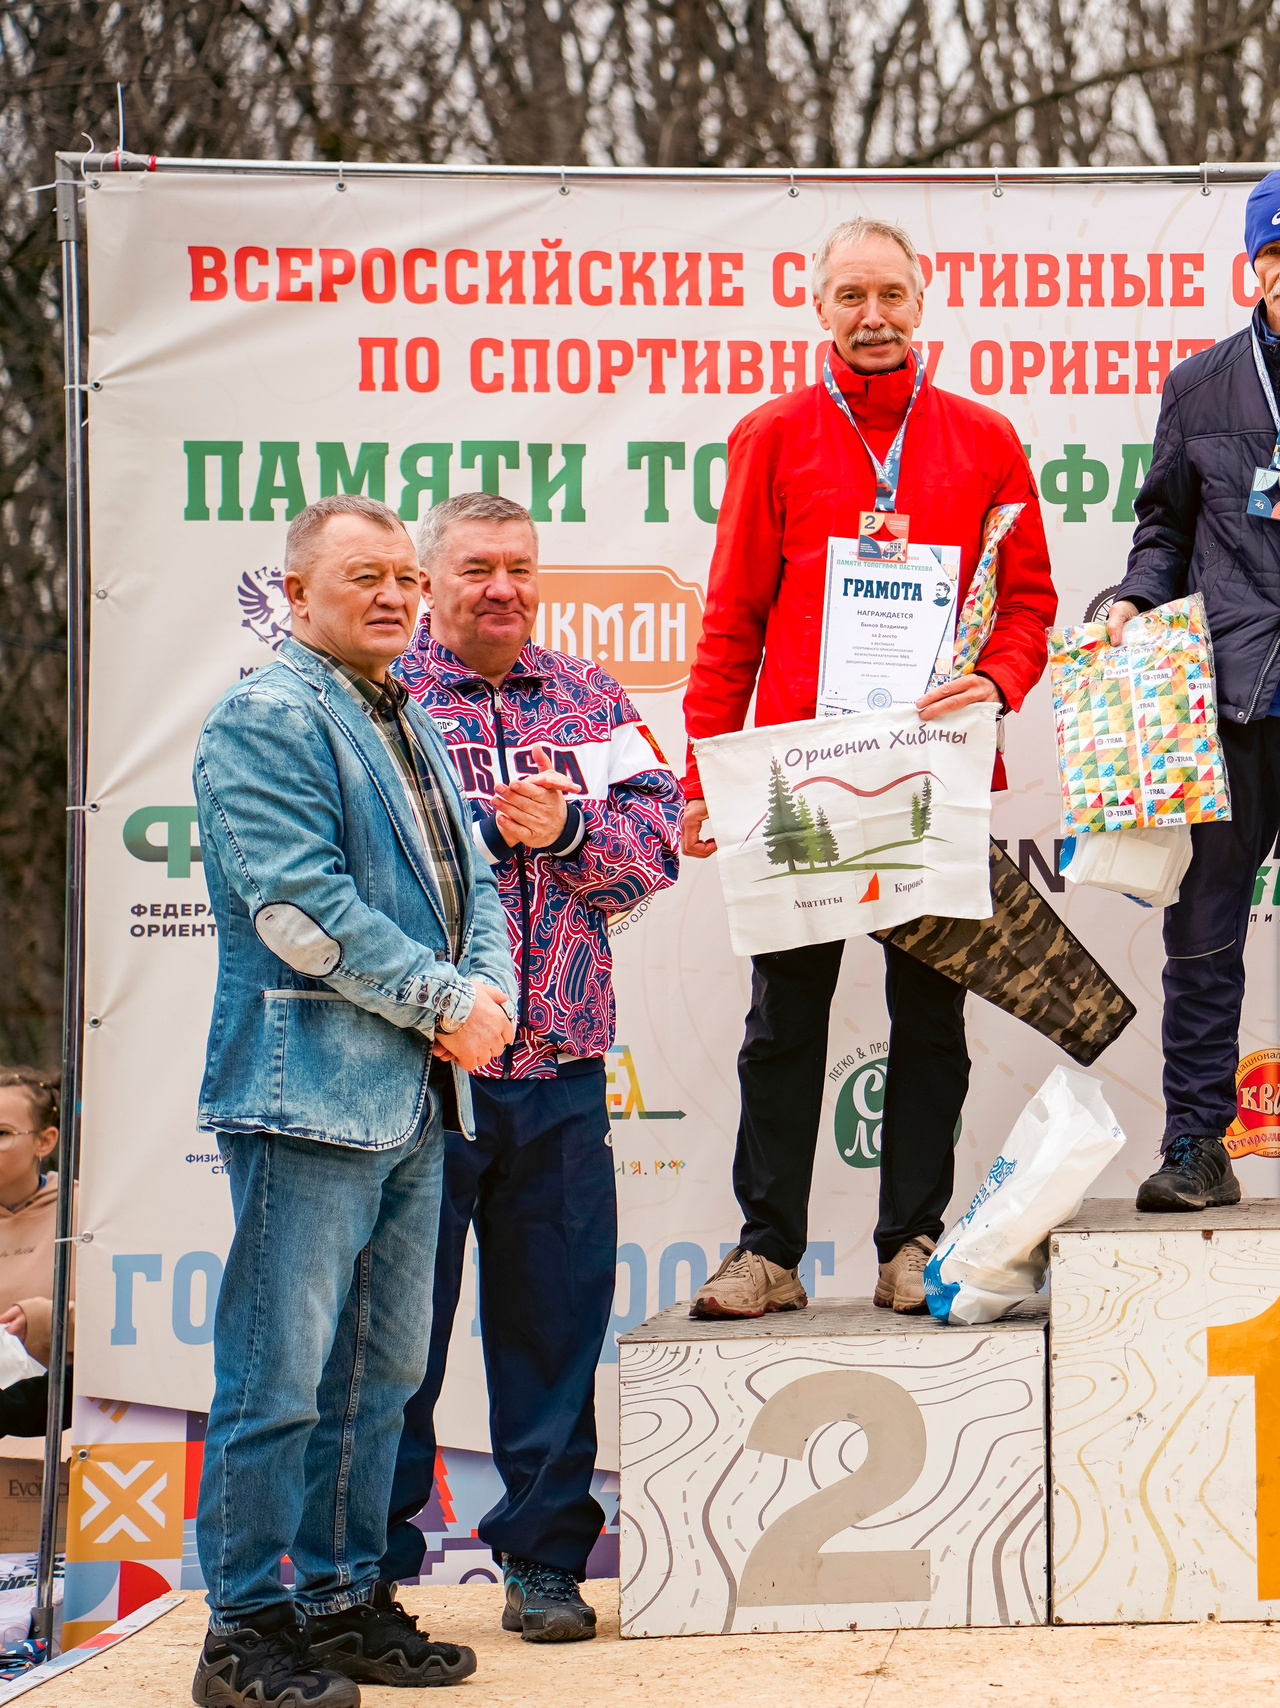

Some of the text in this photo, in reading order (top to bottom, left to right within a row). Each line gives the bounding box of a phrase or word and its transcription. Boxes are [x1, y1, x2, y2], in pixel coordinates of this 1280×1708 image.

[187, 238, 744, 307] ВСЕРОССИЙСКИЕ
[772, 251, 1205, 308] СТИВНЫЕ
[358, 337, 440, 393] ПО
[183, 440, 587, 523] ПАМЯТИ
[864, 515, 876, 529] 2
[842, 577, 923, 601] ГРАМОТА
[856, 609, 914, 619] НАГРАЖДАЕТСЯ
[784, 723, 968, 771] Ориент Хибины
[793, 894, 844, 910] Апатиты
[828, 1054, 855, 1082] ЛЕГКО
[738, 1367, 932, 1608] 2
